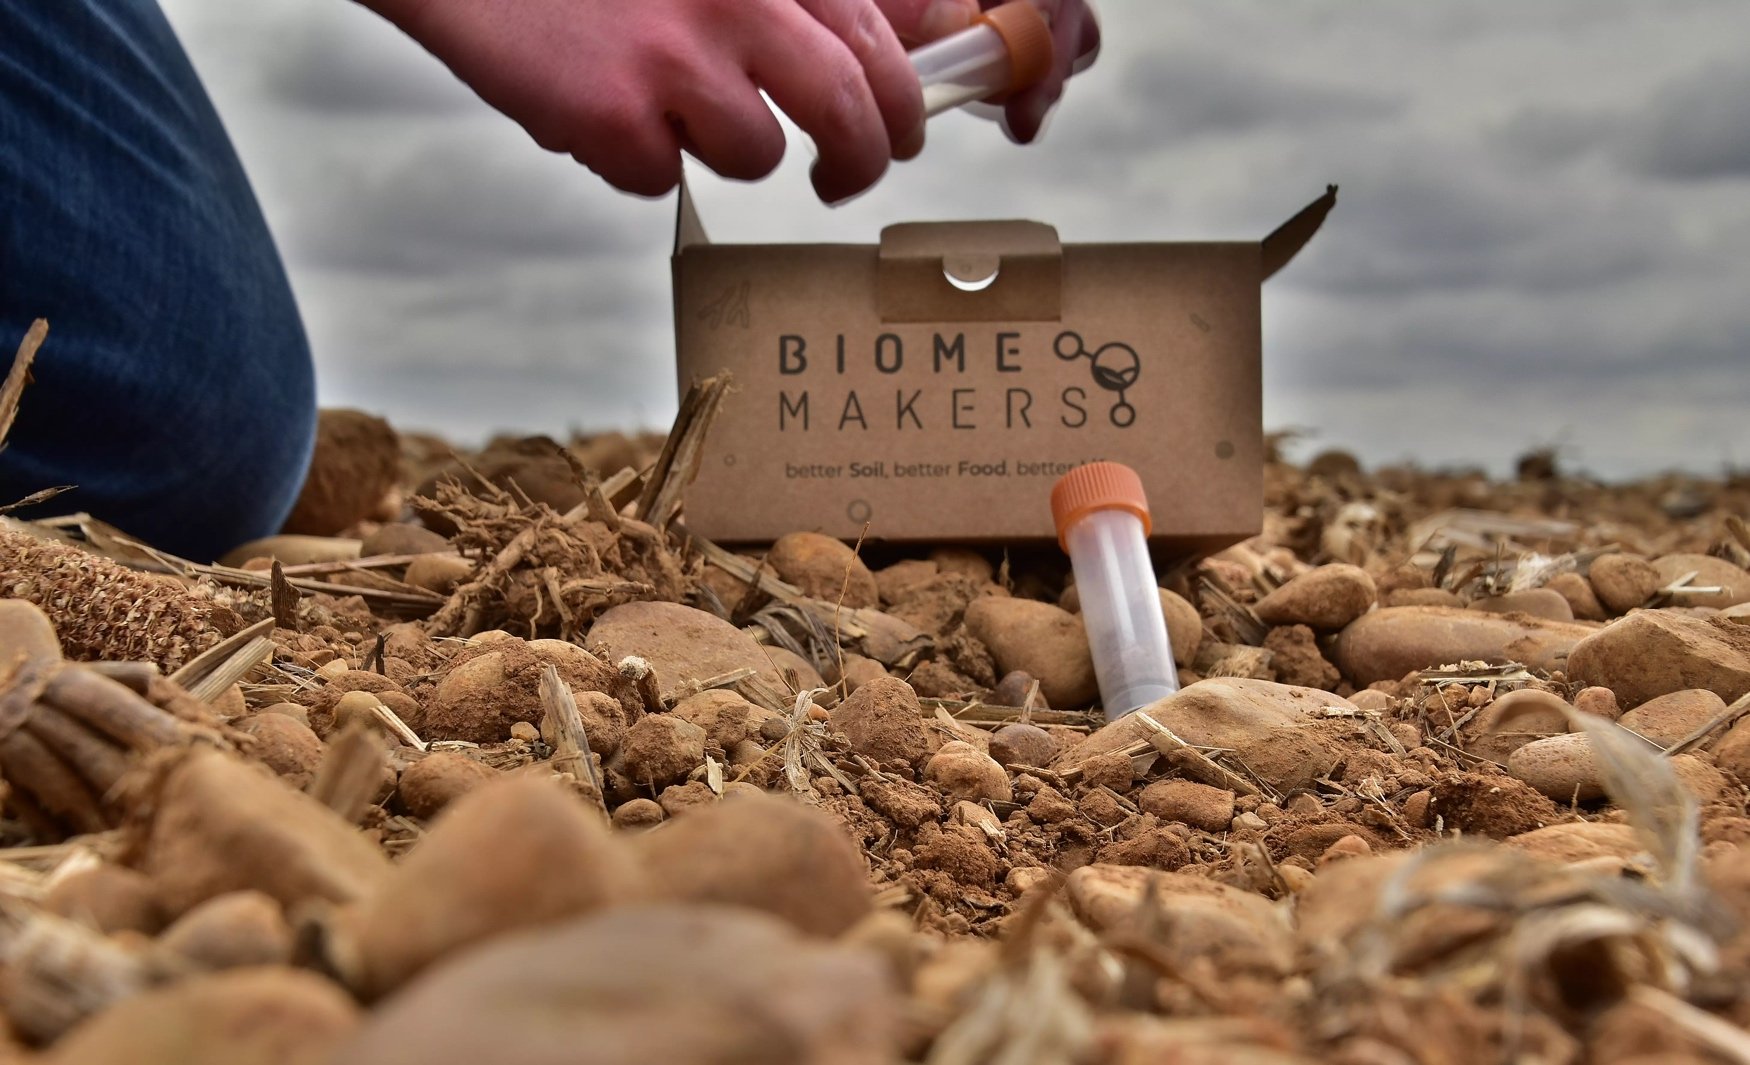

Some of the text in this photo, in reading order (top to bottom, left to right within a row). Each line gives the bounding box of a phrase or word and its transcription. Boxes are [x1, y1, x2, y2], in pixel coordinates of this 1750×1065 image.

[778, 332, 1022, 375] BIOME
[779, 387, 1087, 431] MAKERS
[786, 463, 842, 478] better
[849, 461, 888, 479] Soil,
[894, 461, 951, 477] better
